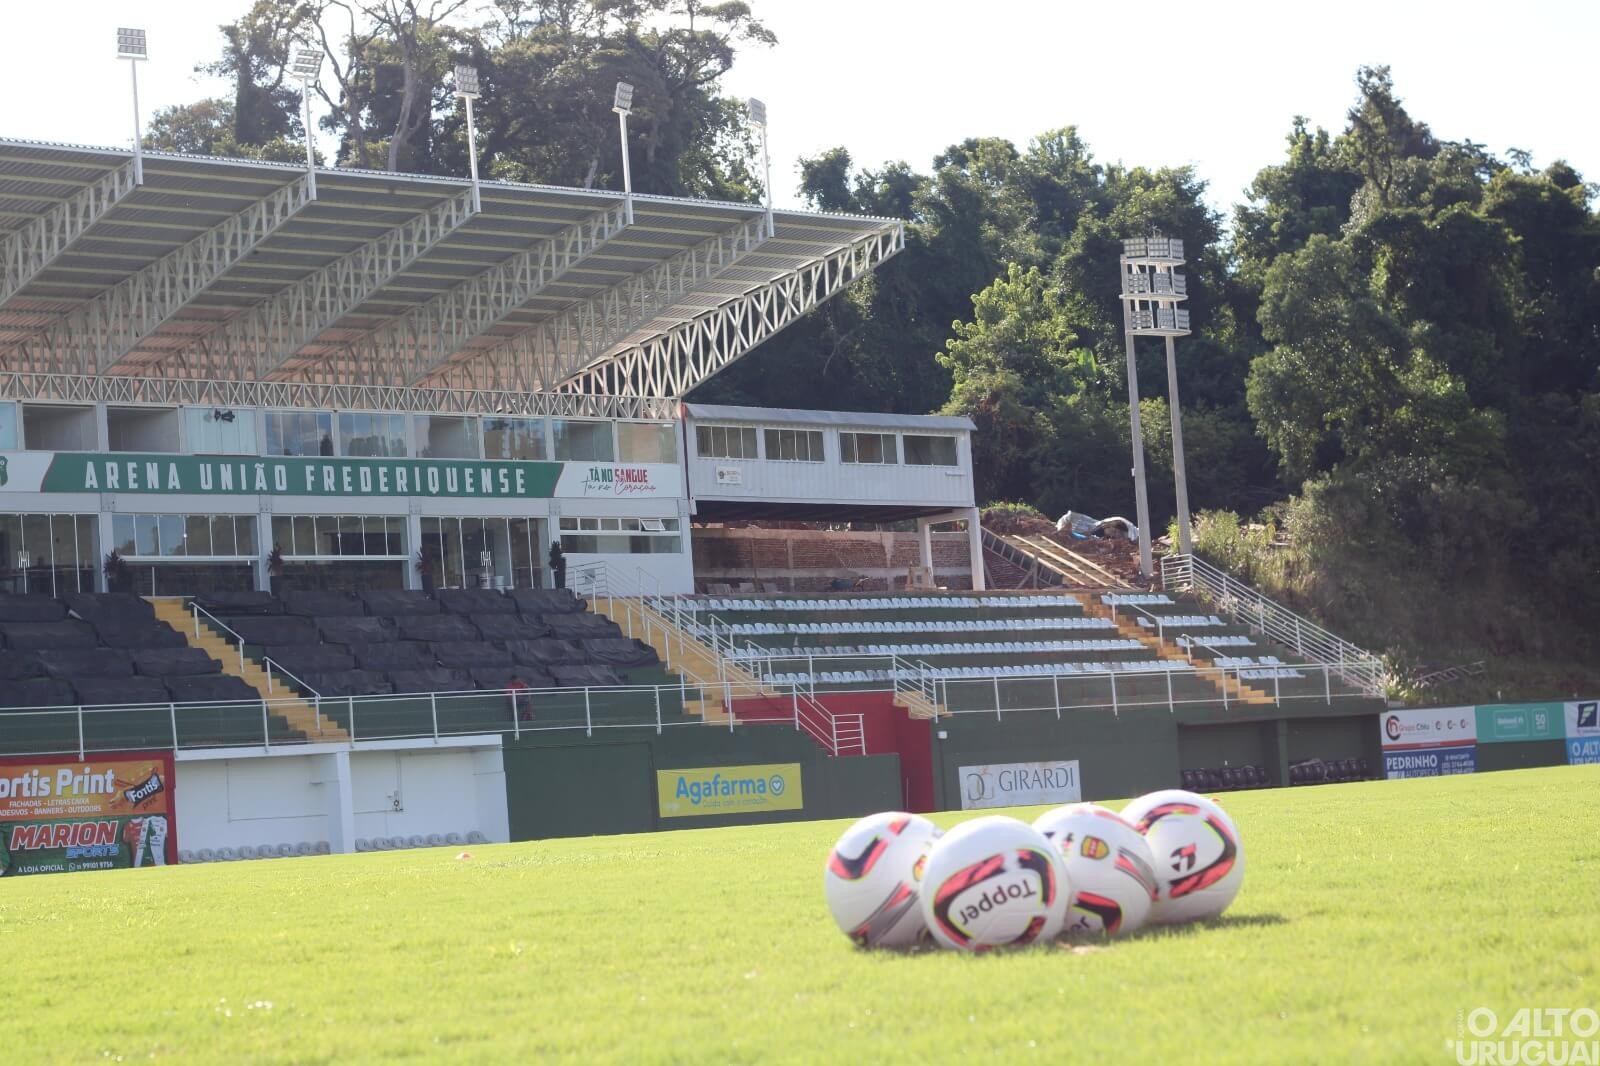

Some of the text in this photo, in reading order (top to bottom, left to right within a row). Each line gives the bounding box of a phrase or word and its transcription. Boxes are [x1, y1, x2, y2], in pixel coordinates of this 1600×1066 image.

[85, 461, 526, 495] ARENA UNIÃO FREDERIQUENSE
[601, 469, 614, 482] NO
[614, 469, 648, 482] SANGUE
[1582, 741, 1600, 756] ALT
[1386, 754, 1438, 771] PEDRINHO
[0, 766, 115, 799] ortis Print
[675, 774, 766, 805] Agafarma
[998, 767, 1075, 792] GIRARDI
[130, 780, 159, 803] Fortis
[9, 800, 42, 808] FACHADAS
[33, 806, 64, 816] BANNERS
[67, 804, 102, 814] OUTDOORS
[10, 821, 119, 851] MARION
[65, 845, 120, 859] SPORTS
[23, 865, 39, 873] LOJA
[40, 864, 65, 872] OFICIAL
[958, 879, 1037, 925] Topper
